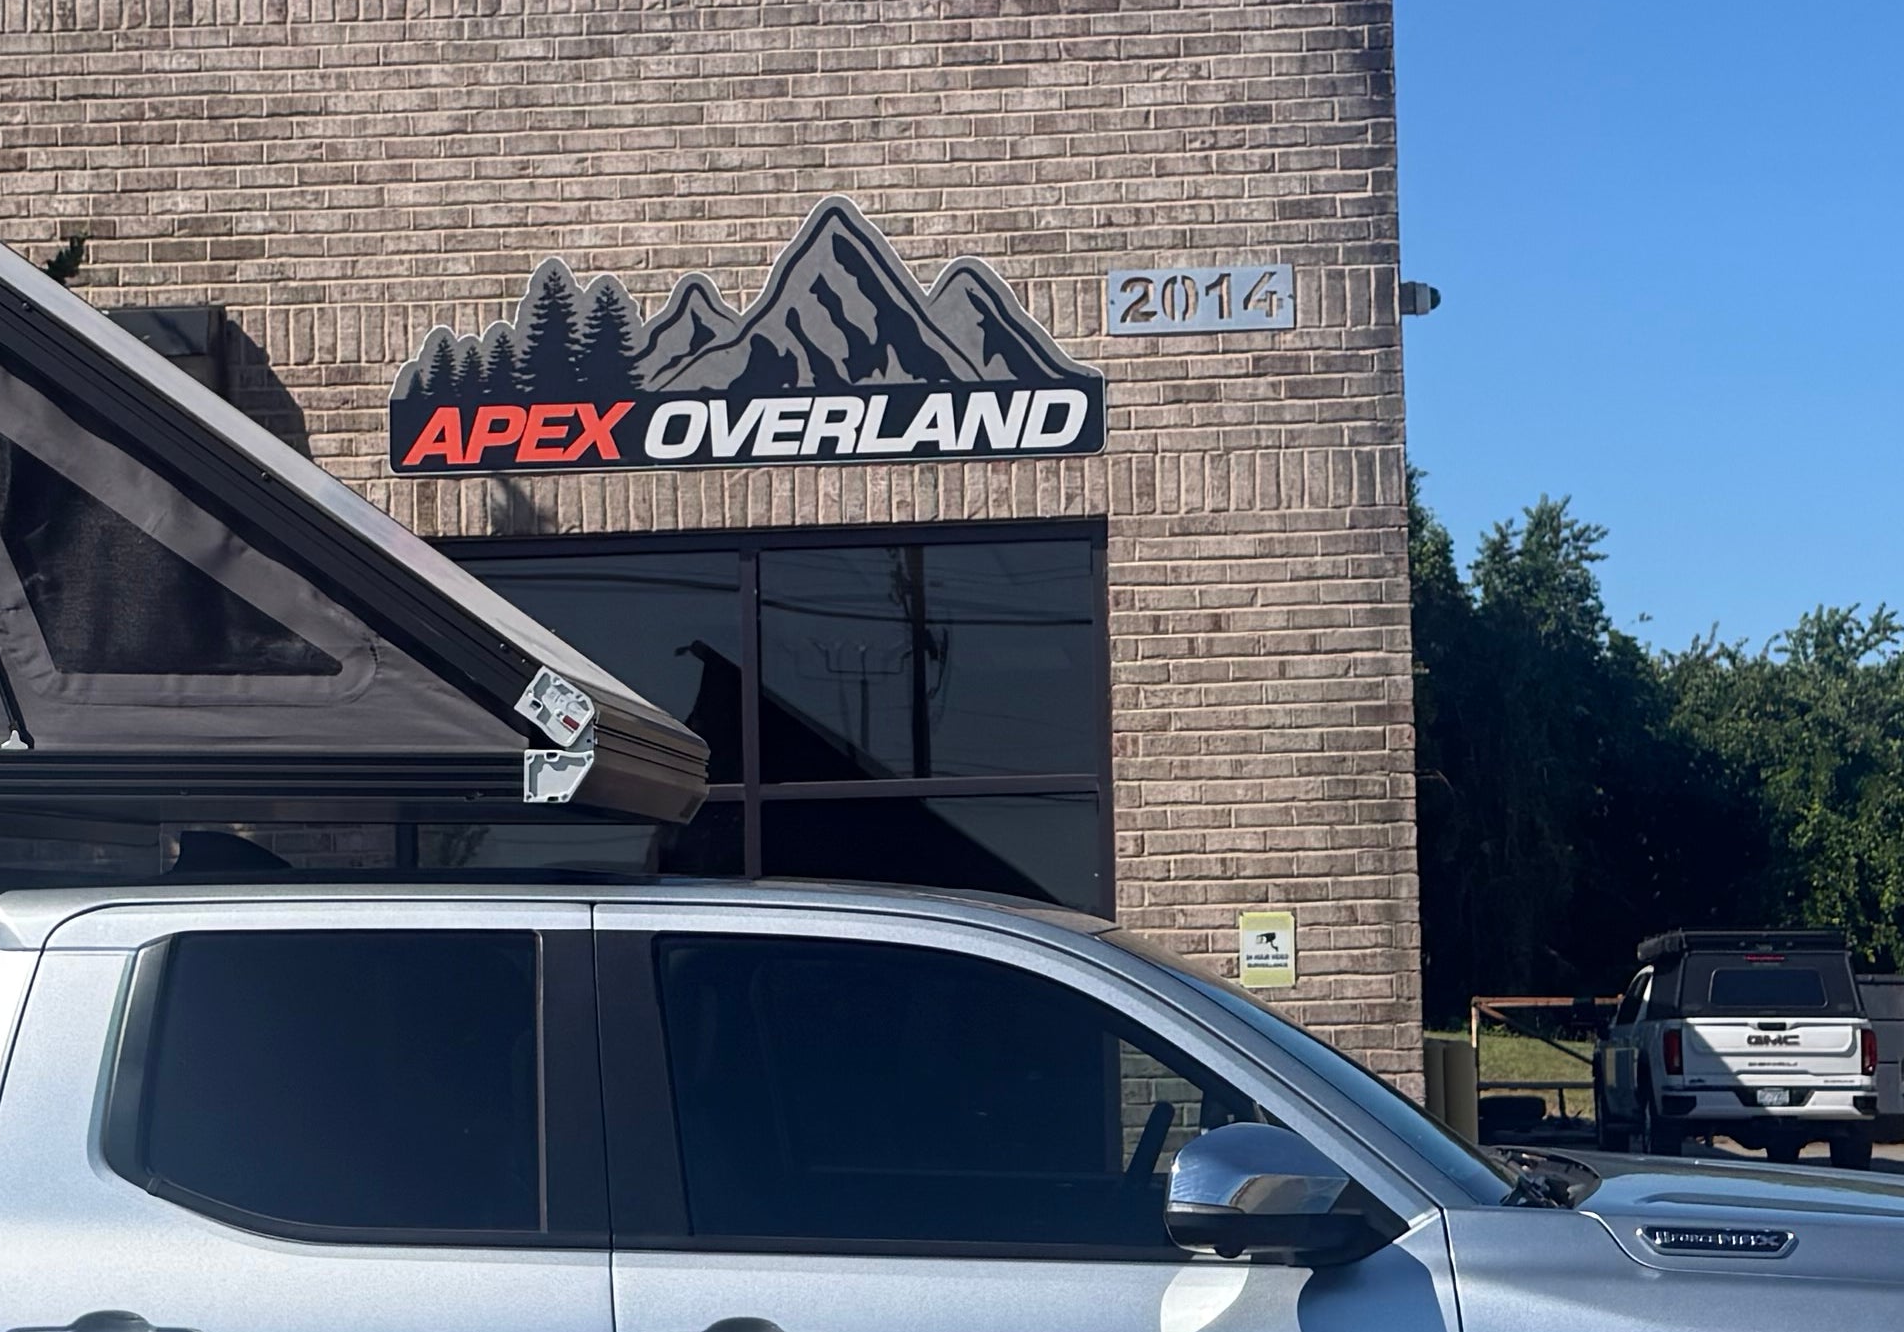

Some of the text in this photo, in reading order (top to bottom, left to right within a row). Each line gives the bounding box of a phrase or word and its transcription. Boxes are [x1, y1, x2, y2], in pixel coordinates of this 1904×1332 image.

[1119, 271, 1284, 325] 2014
[401, 389, 1089, 466] APEX OVERLAND
[1747, 1034, 1801, 1046] GMC
